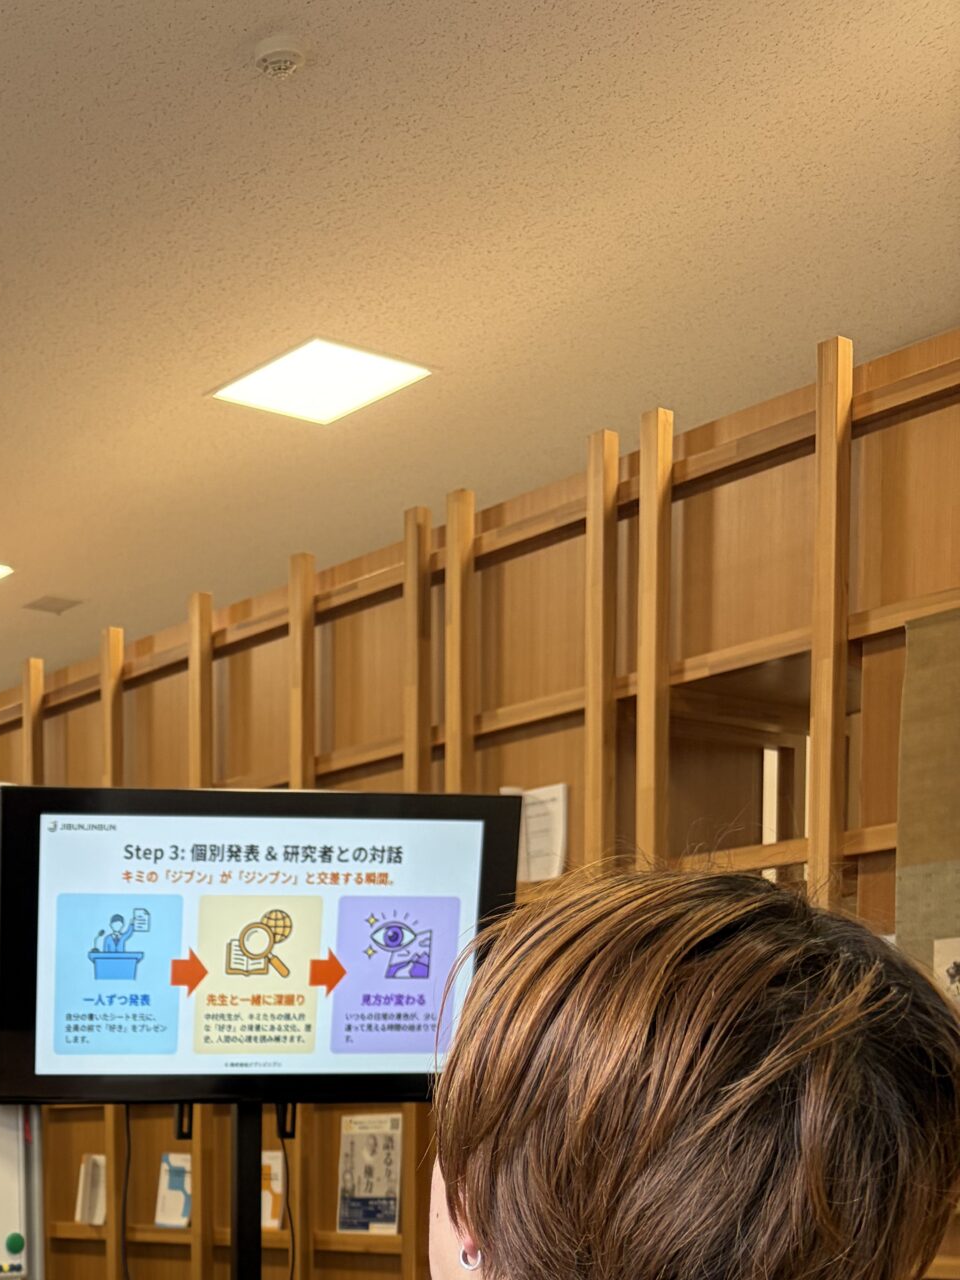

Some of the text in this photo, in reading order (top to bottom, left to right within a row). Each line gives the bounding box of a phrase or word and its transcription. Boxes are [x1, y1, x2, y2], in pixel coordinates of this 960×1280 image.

[123, 843, 404, 865] Step 3: 個別発表 & 研究者との対話
[82, 993, 151, 1006] 一人ずつ発表
[361, 993, 426, 1006] 見方が変わる
